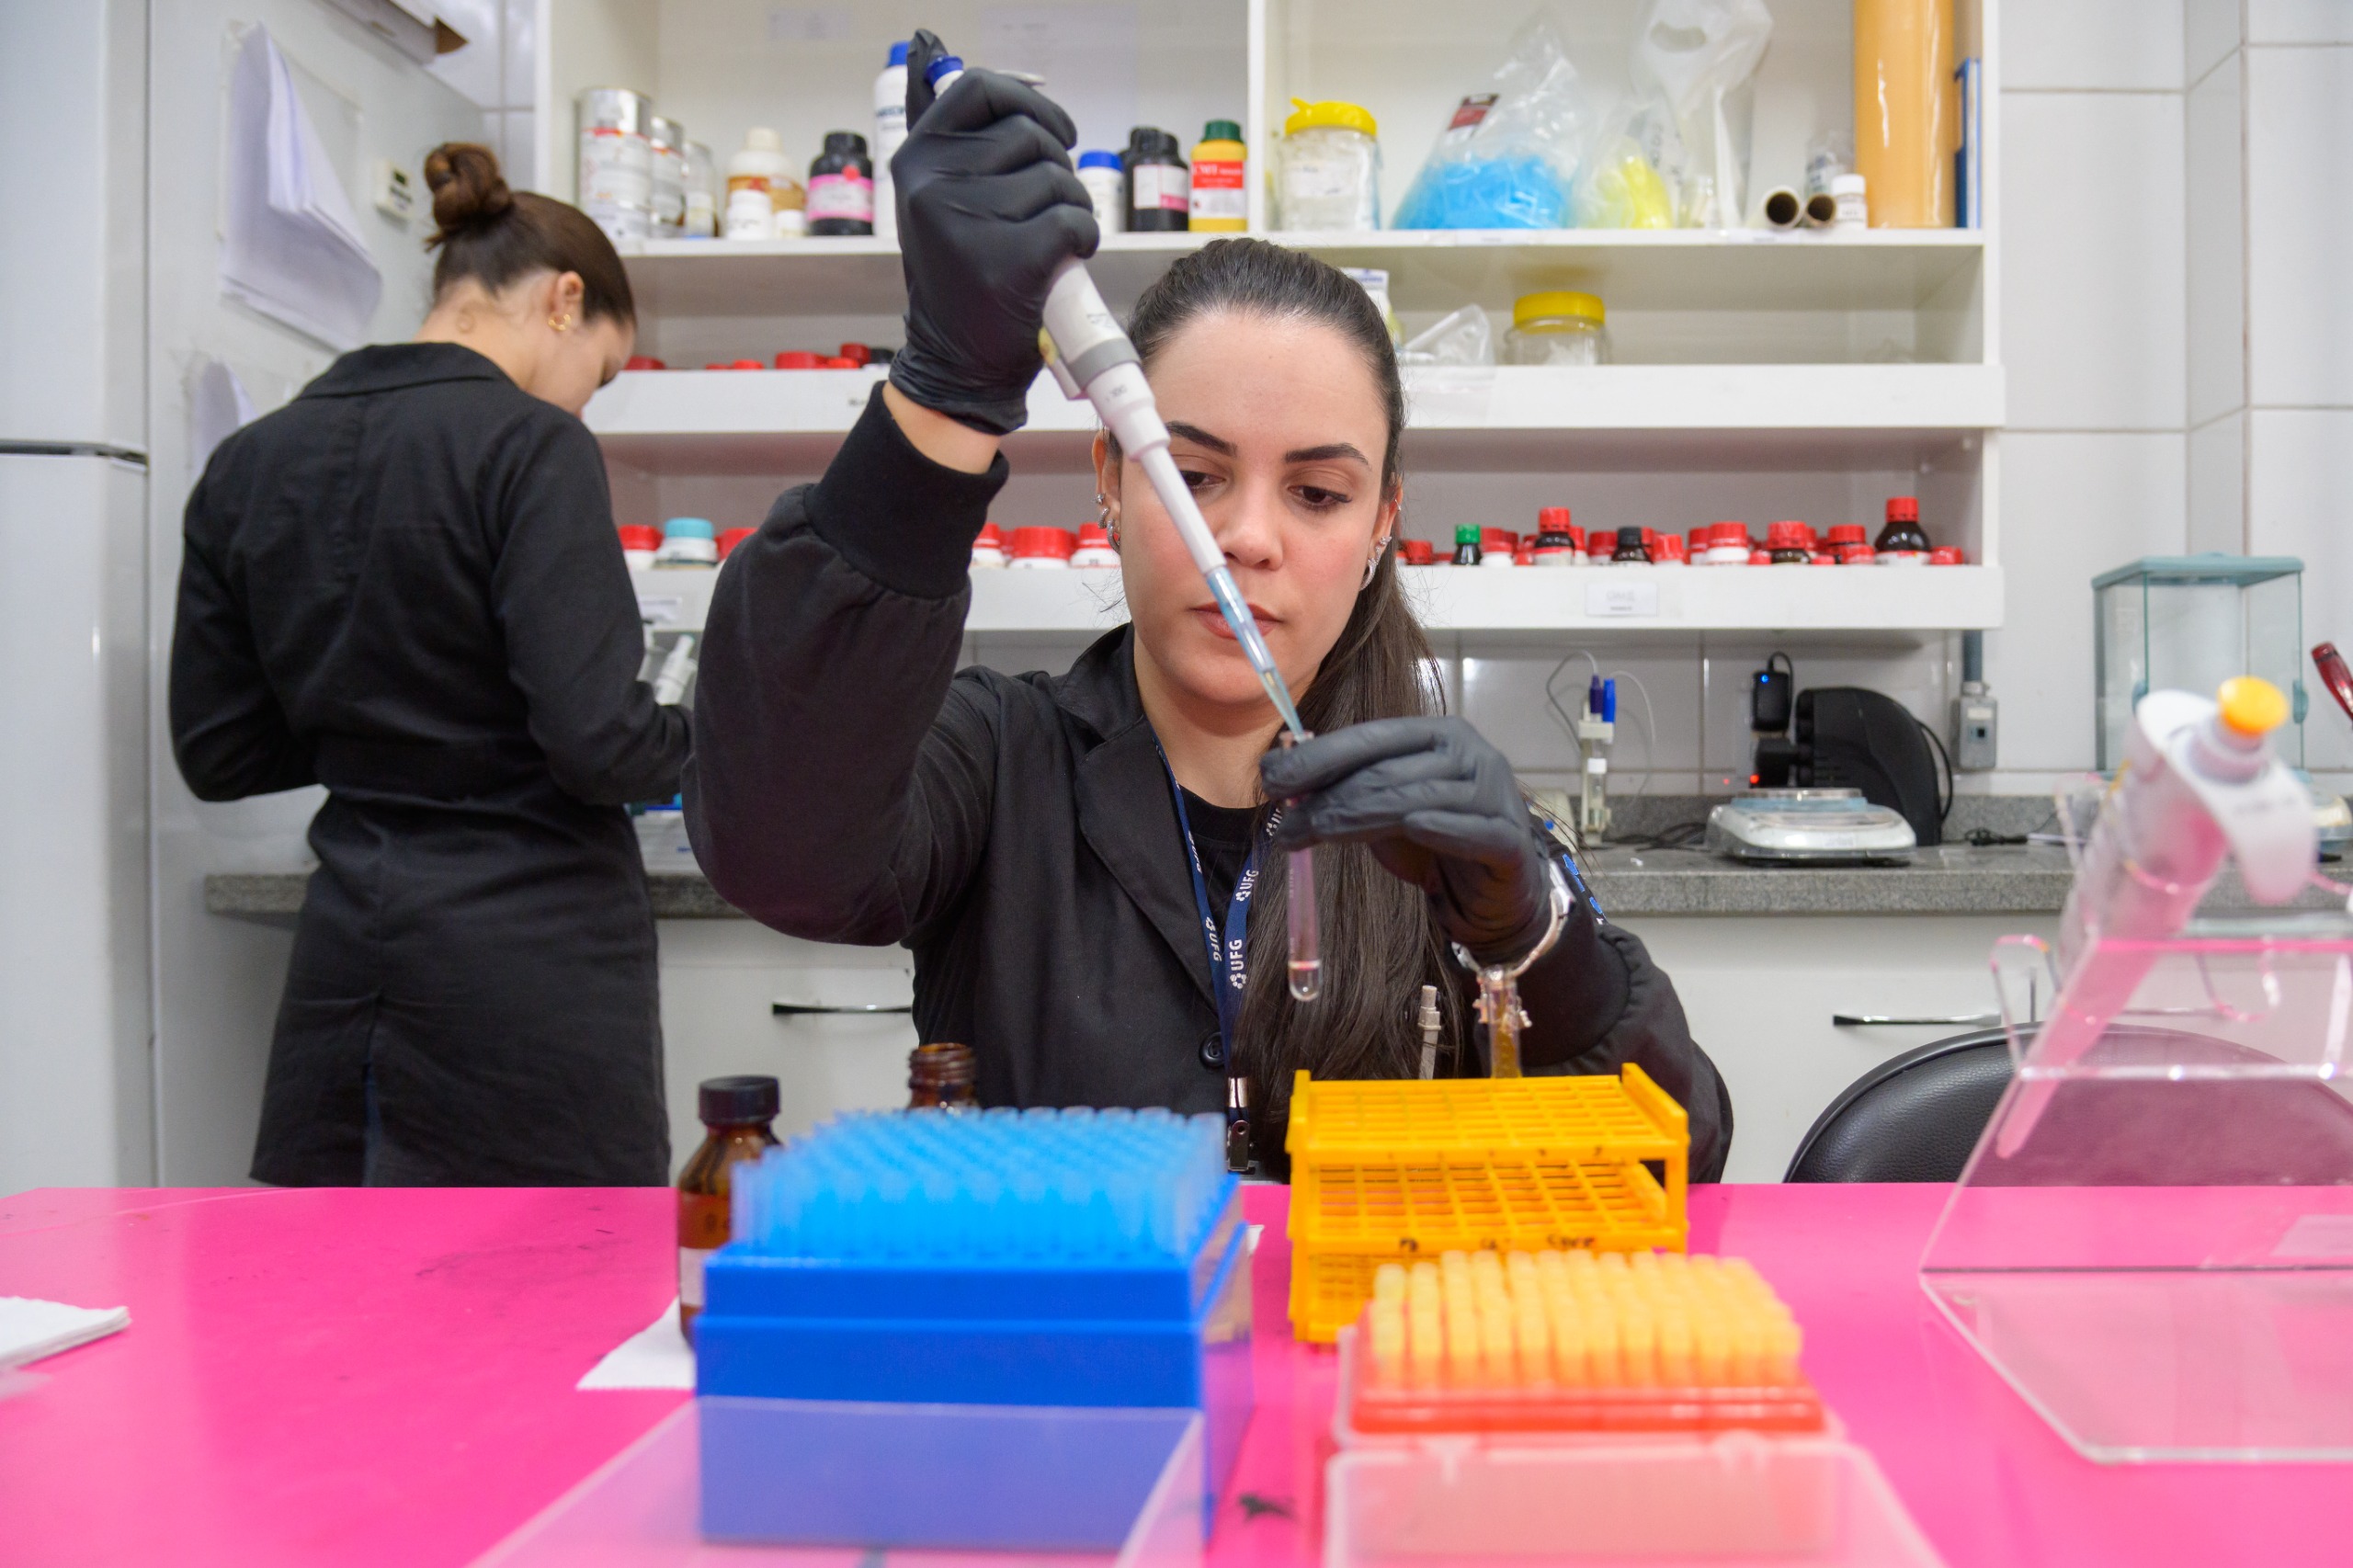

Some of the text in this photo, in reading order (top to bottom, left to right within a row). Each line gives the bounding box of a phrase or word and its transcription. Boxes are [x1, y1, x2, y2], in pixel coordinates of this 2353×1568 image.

[1239, 869, 1259, 890] UFG
[1210, 932, 1222, 962] UFG
[1228, 938, 1245, 971] UFG
